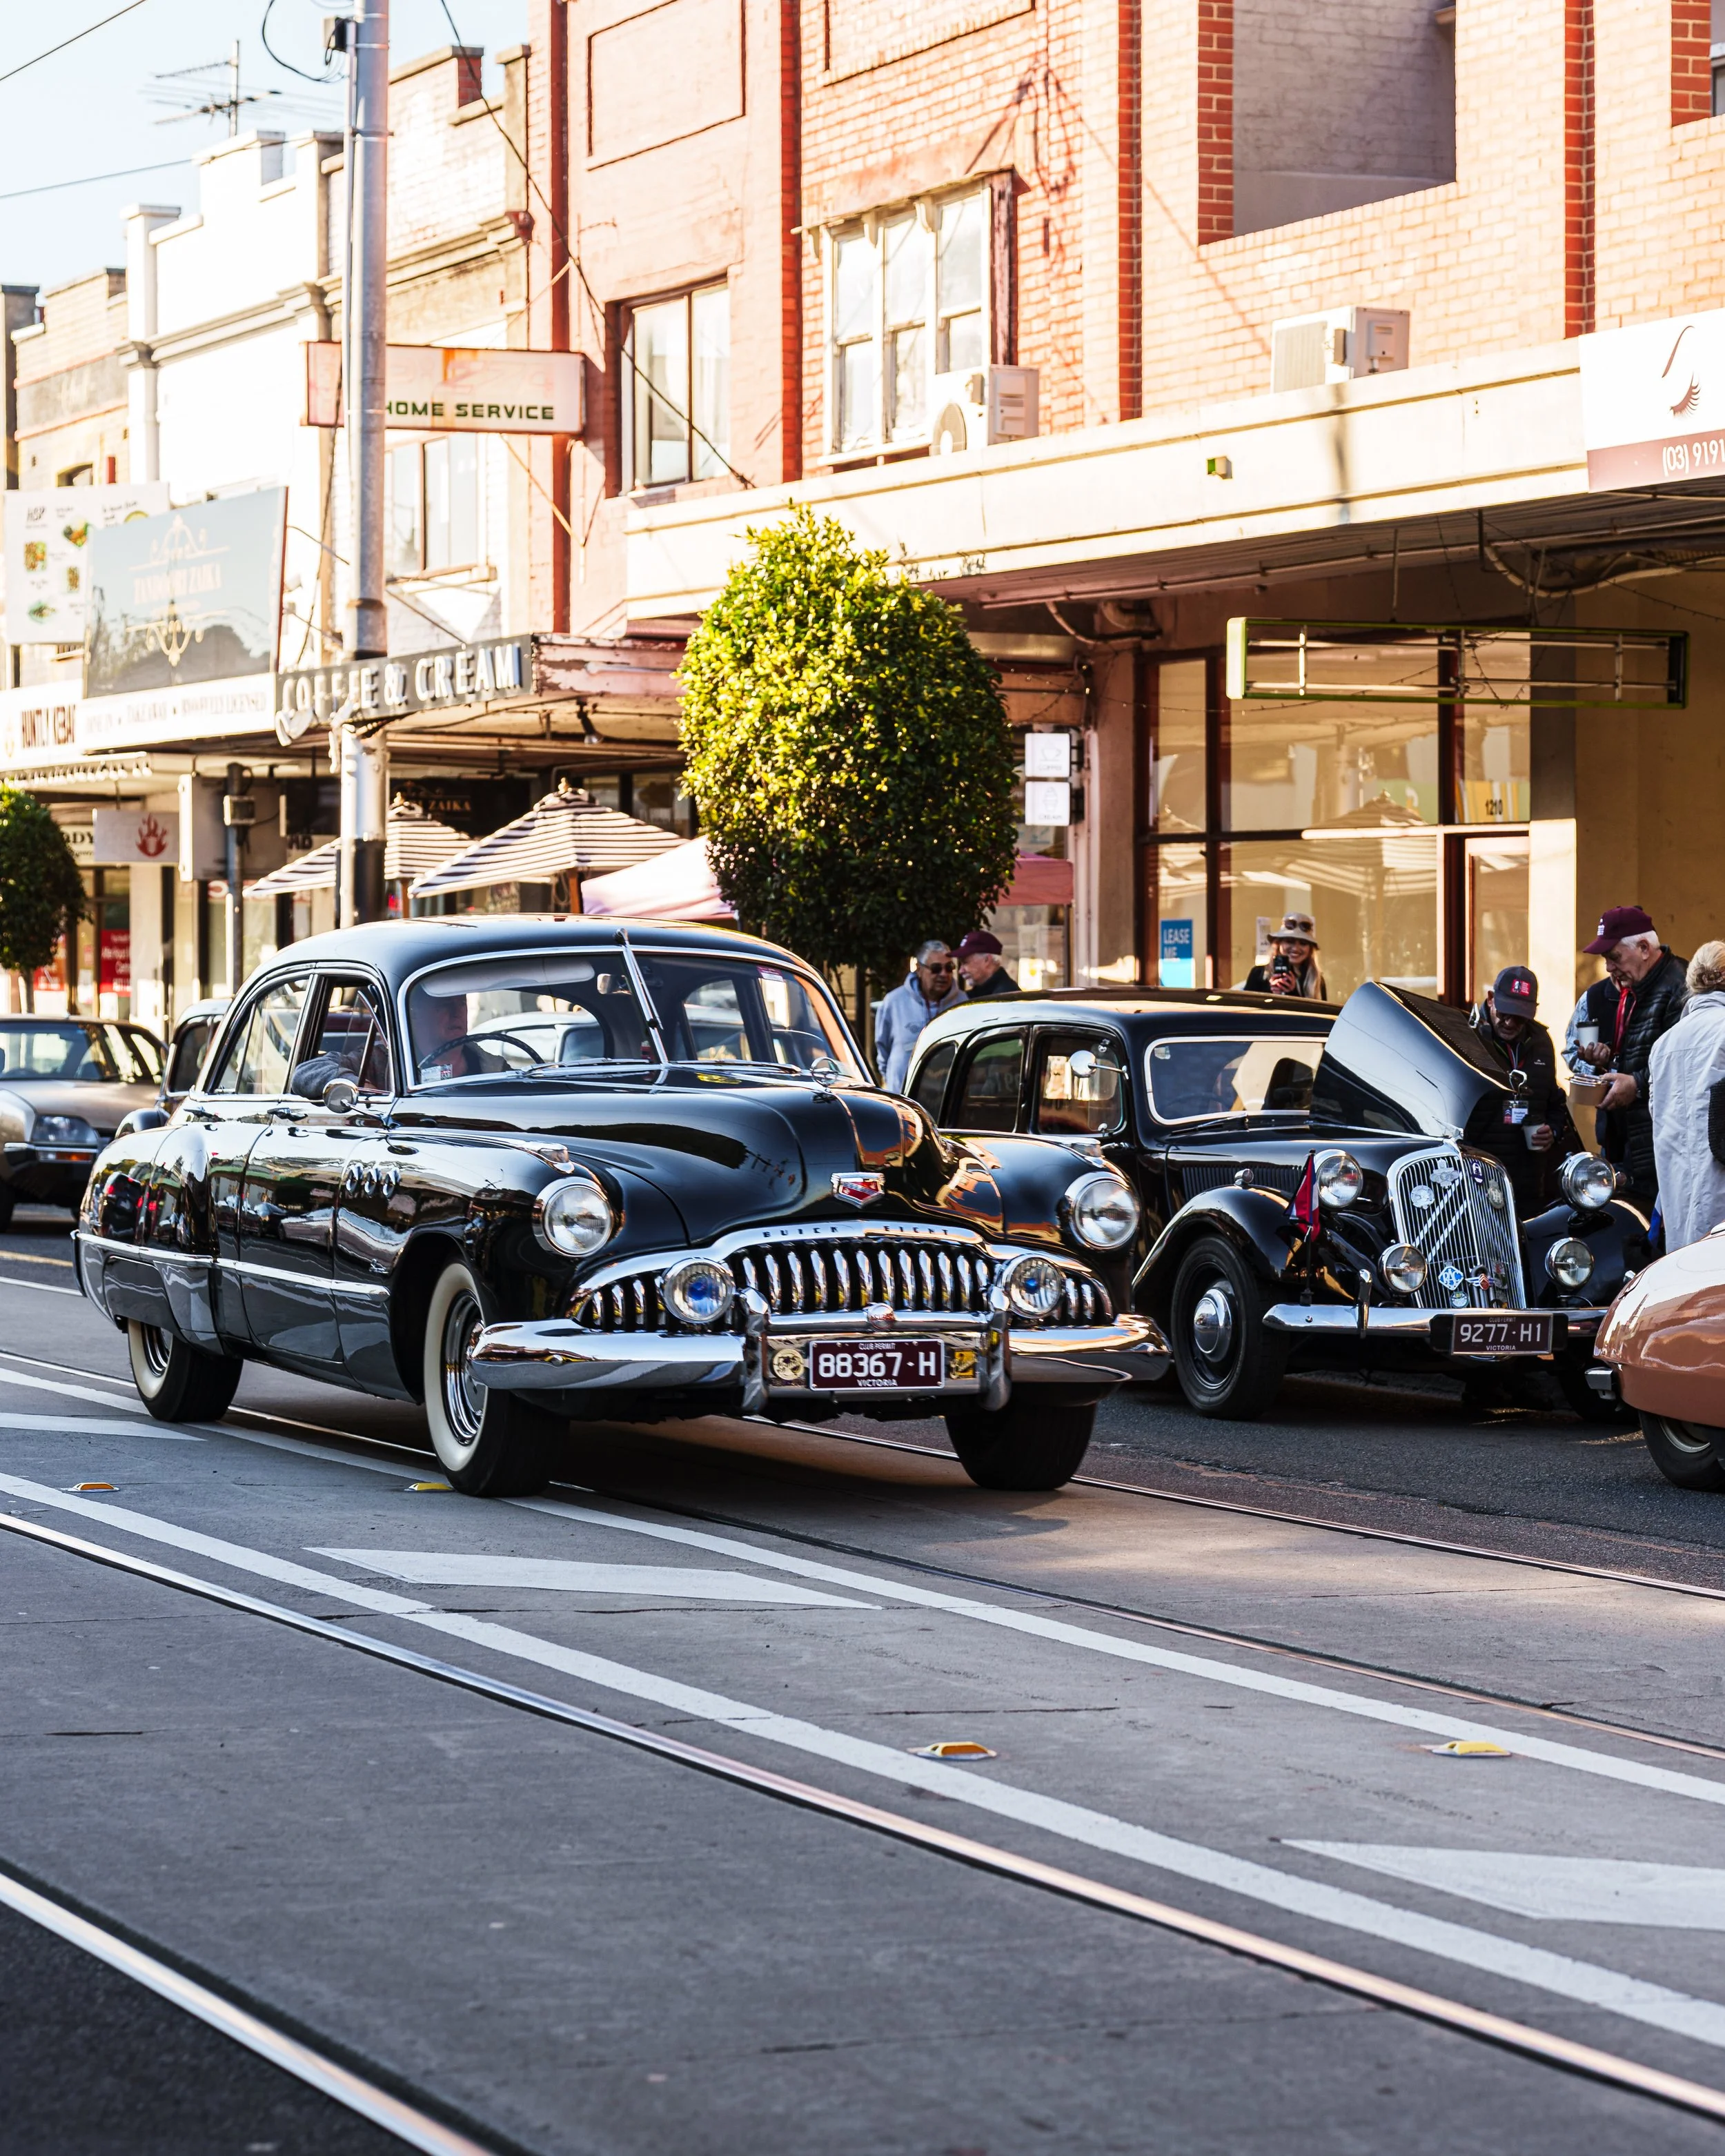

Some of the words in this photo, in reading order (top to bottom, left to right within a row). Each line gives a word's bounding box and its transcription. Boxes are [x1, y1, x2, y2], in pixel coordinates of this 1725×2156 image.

[455, 404, 554, 420] SERVICE
[1662, 443, 1689, 477] (03)
[282, 666, 379, 718] COFFEE
[384, 663, 408, 706] &
[415, 643, 522, 702] CREAM
[1485, 799, 1503, 815] 1210
[1163, 928, 1190, 944] LEASE
[762, 1226, 840, 1238] BUICK
